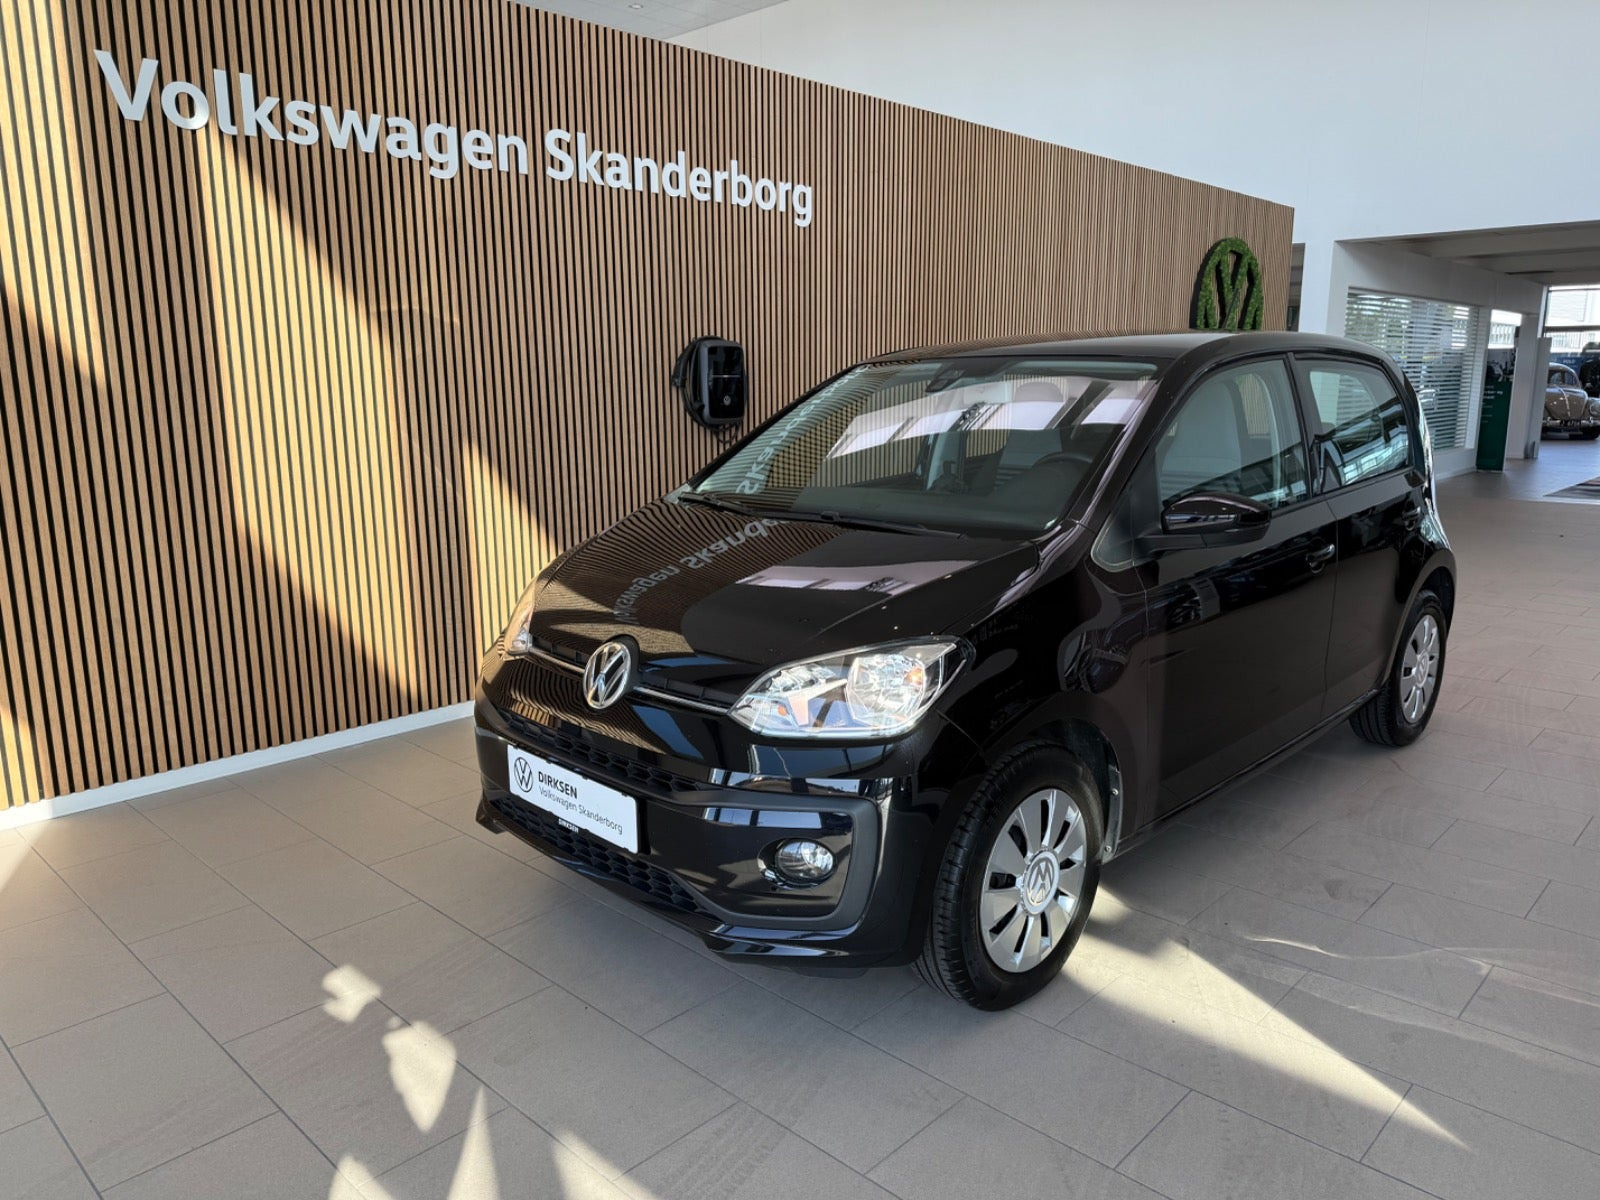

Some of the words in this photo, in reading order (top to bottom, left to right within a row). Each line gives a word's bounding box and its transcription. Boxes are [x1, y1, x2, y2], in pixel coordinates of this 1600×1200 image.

[94, 49, 528, 180] Volkswagen
[545, 128, 813, 227] Skanderborg
[538, 771, 578, 799] DIRKSEN
[539, 785, 578, 811] Volkswagen
[578, 804, 623, 835] Skanderborg
